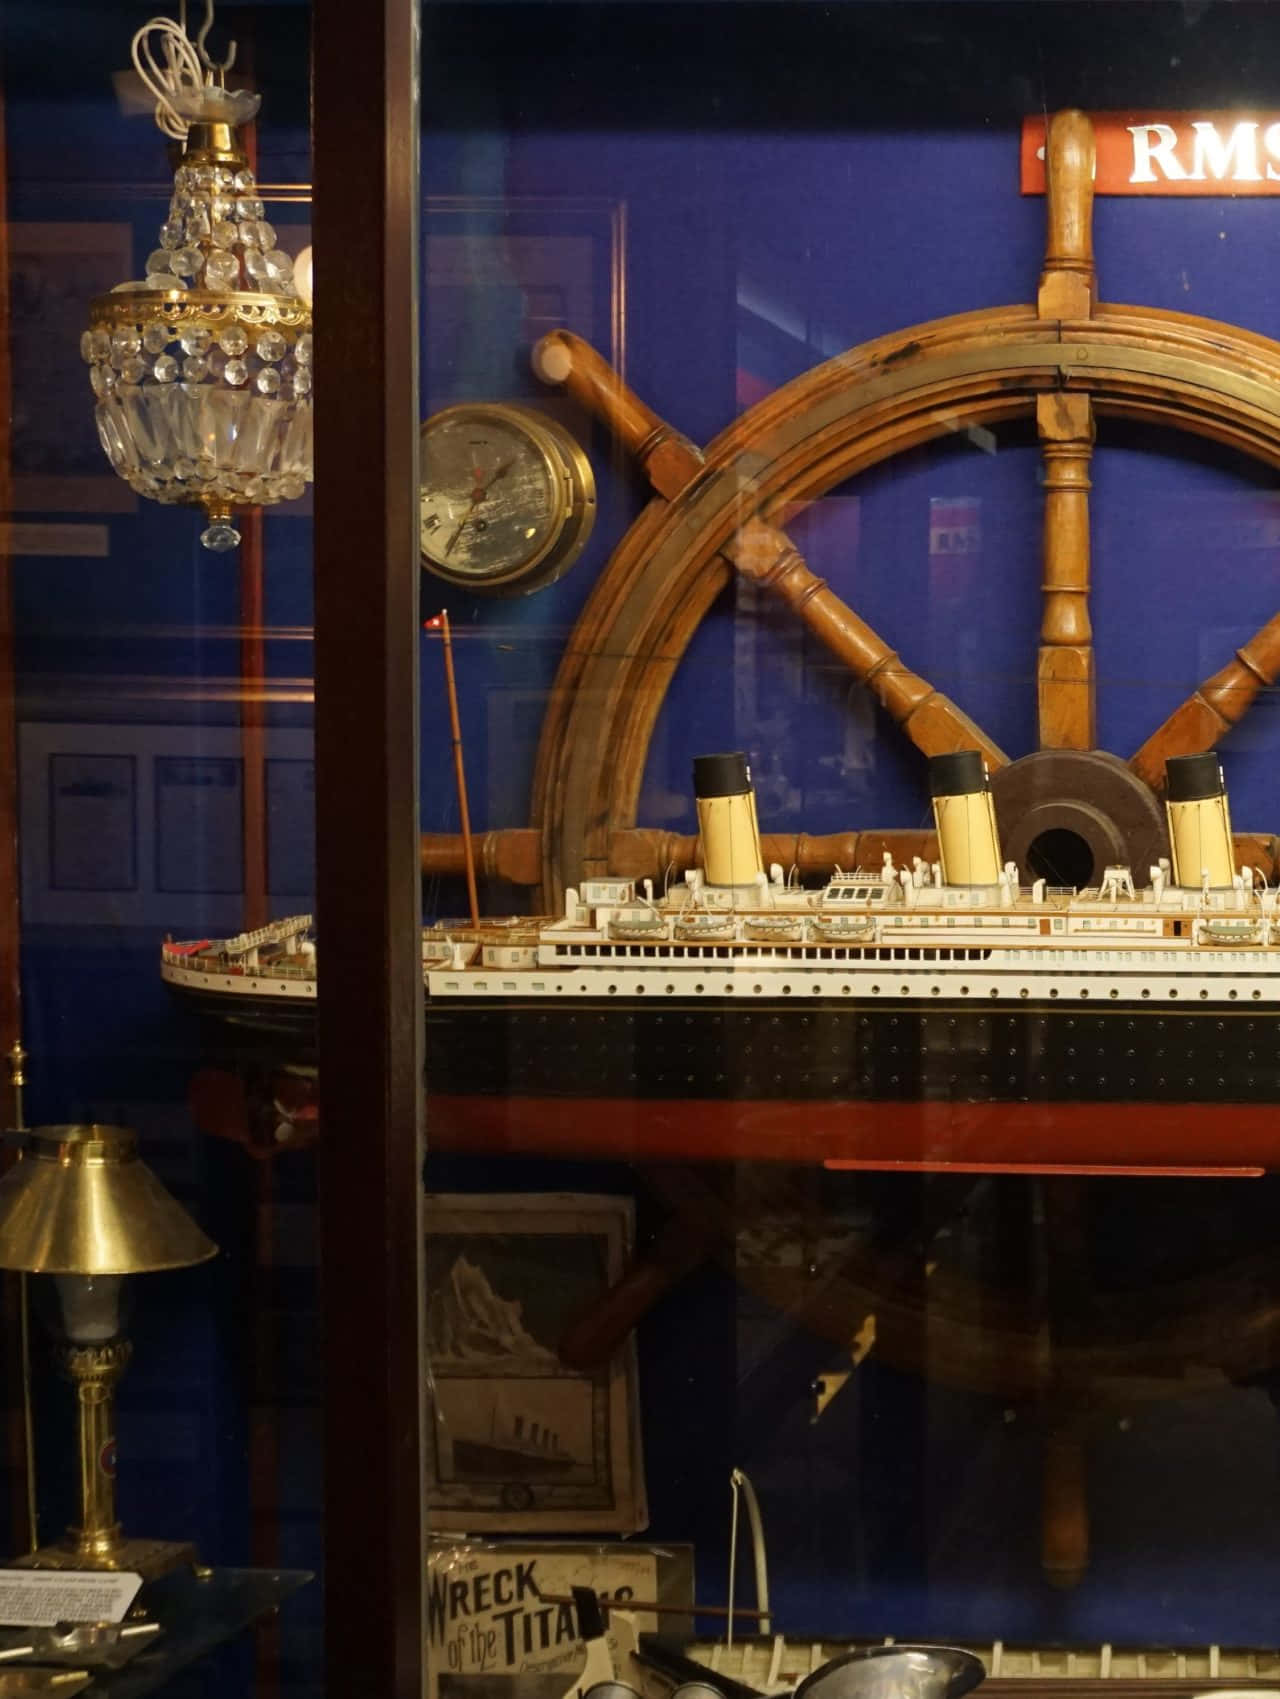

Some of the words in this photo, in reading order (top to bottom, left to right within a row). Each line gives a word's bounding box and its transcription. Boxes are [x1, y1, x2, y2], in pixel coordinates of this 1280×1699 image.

[426, 1559, 541, 1649] WRECK
[447, 1623, 469, 1672] of
[470, 1621, 497, 1671] the
